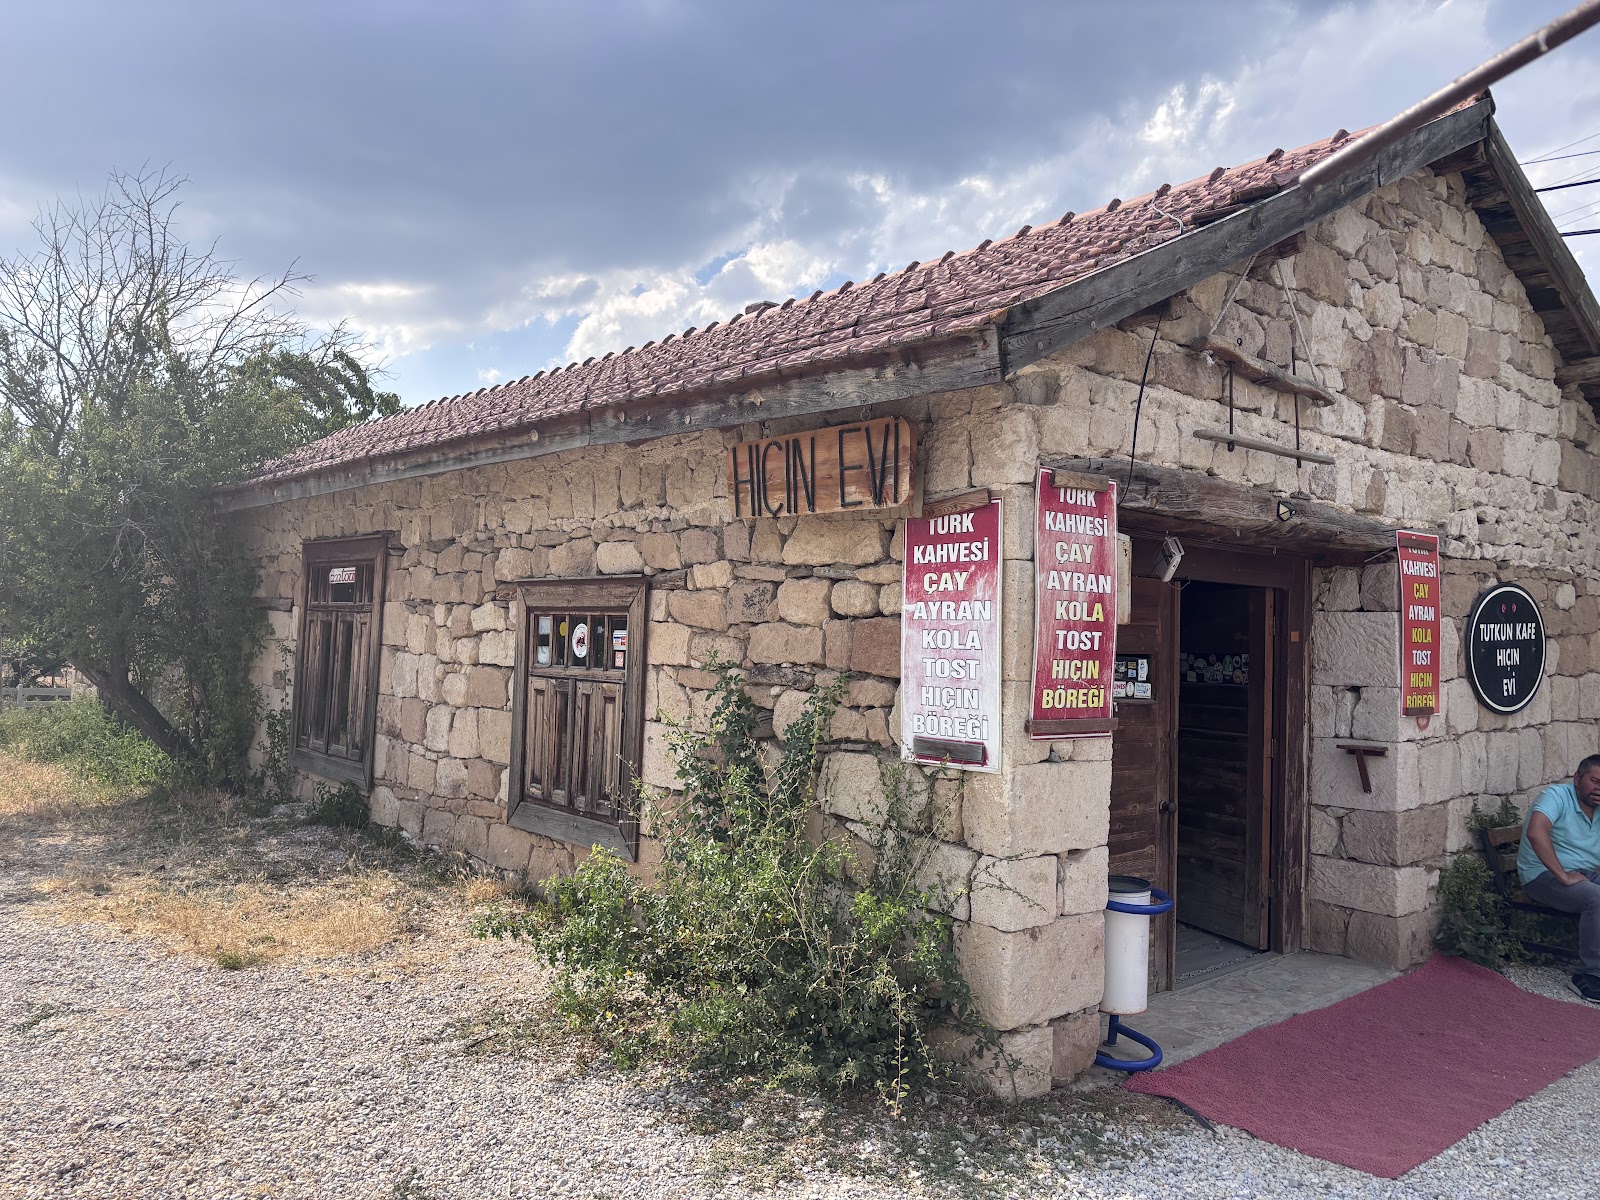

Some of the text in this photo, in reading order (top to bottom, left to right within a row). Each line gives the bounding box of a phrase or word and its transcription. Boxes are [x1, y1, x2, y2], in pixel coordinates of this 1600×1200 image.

[1045, 510, 1108, 537] KAHVESİ
[913, 536, 989, 564] KAHVESİ
[1055, 541, 1094, 565] ÇAY
[1402, 560, 1437, 578] KAHVESİ
[923, 571, 969, 595] ÇAY
[1047, 570, 1112, 594] AYRAN
[1413, 582, 1429, 600] ÇAY
[913, 600, 991, 621] AYRAN
[1055, 600, 1104, 622] KOLA
[1408, 605, 1435, 622] AYRAN
[921, 629, 982, 650] KOLA
[1055, 630, 1102, 650] TOST
[1412, 628, 1432, 643] KOLA
[1480, 622, 1536, 641] TUTKUN KAFE
[922, 657, 980, 680] TOST
[1412, 650, 1432, 665] TOST
[1496, 648, 1520, 671] HIÇIN
[1051, 659, 1100, 681] HIÇIN
[1410, 672, 1433, 689] HIÇIN
[1503, 671, 1516, 696] EVİ
[920, 686, 980, 710] HIÇIN
[1042, 684, 1105, 708] BÖREĞİ
[912, 711, 989, 740] BÖREĞİ
